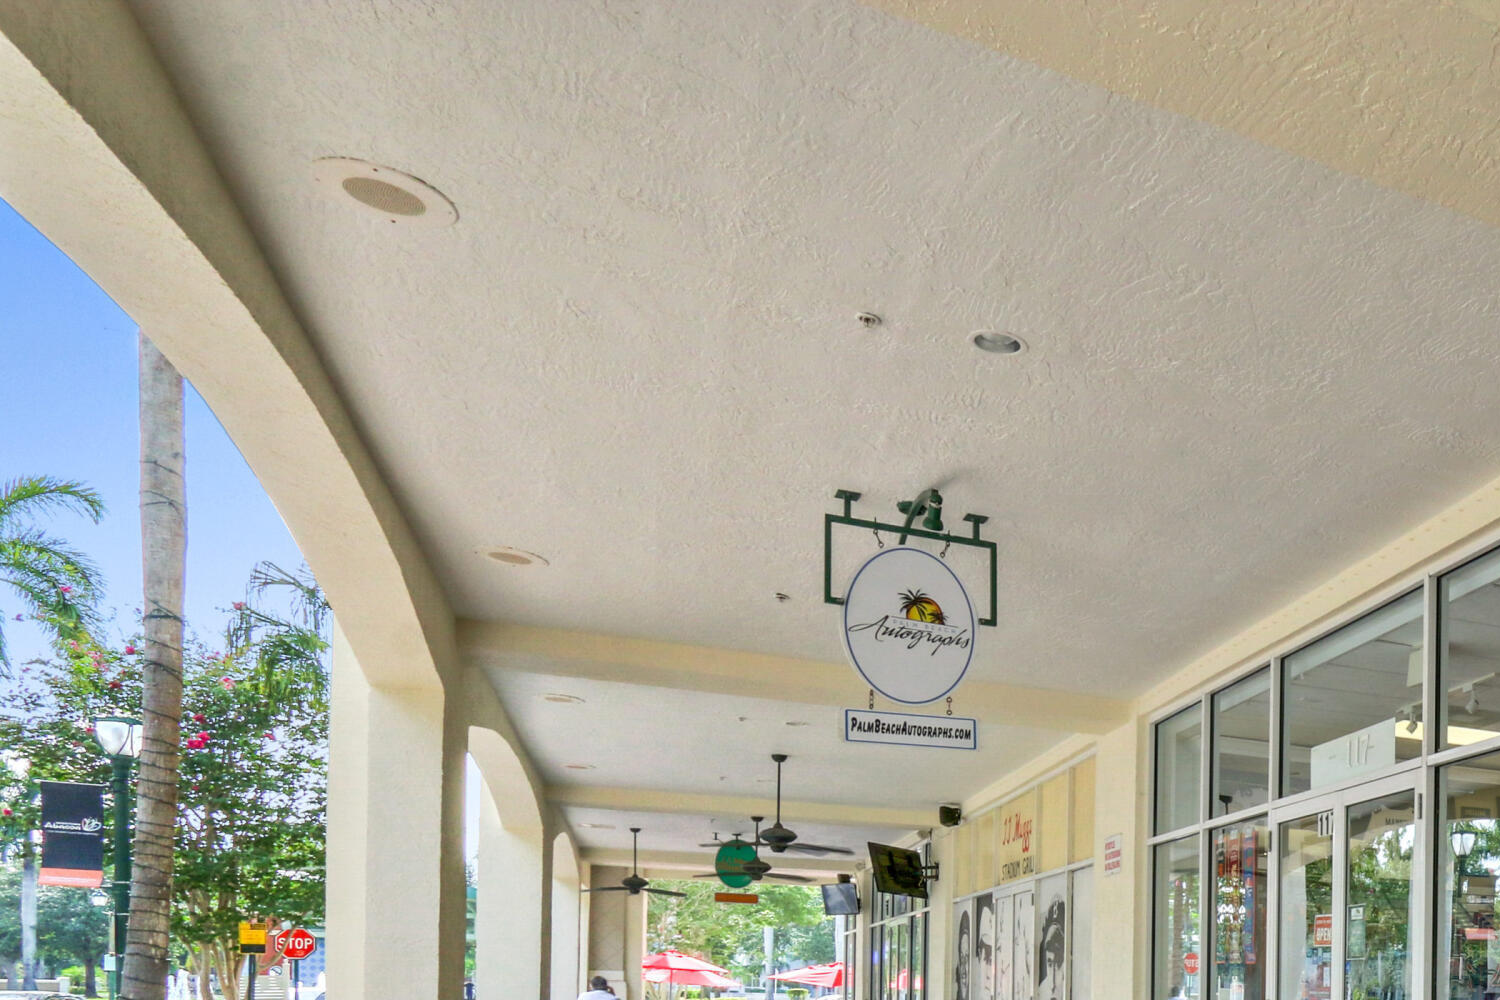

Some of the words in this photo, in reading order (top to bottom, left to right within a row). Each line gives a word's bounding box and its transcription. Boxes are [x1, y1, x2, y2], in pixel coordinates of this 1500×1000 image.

[892, 618, 919, 629] PALM
[924, 624, 956, 634] BEACH
[848, 615, 970, 656] Autographs
[277, 937, 313, 950] STOP
